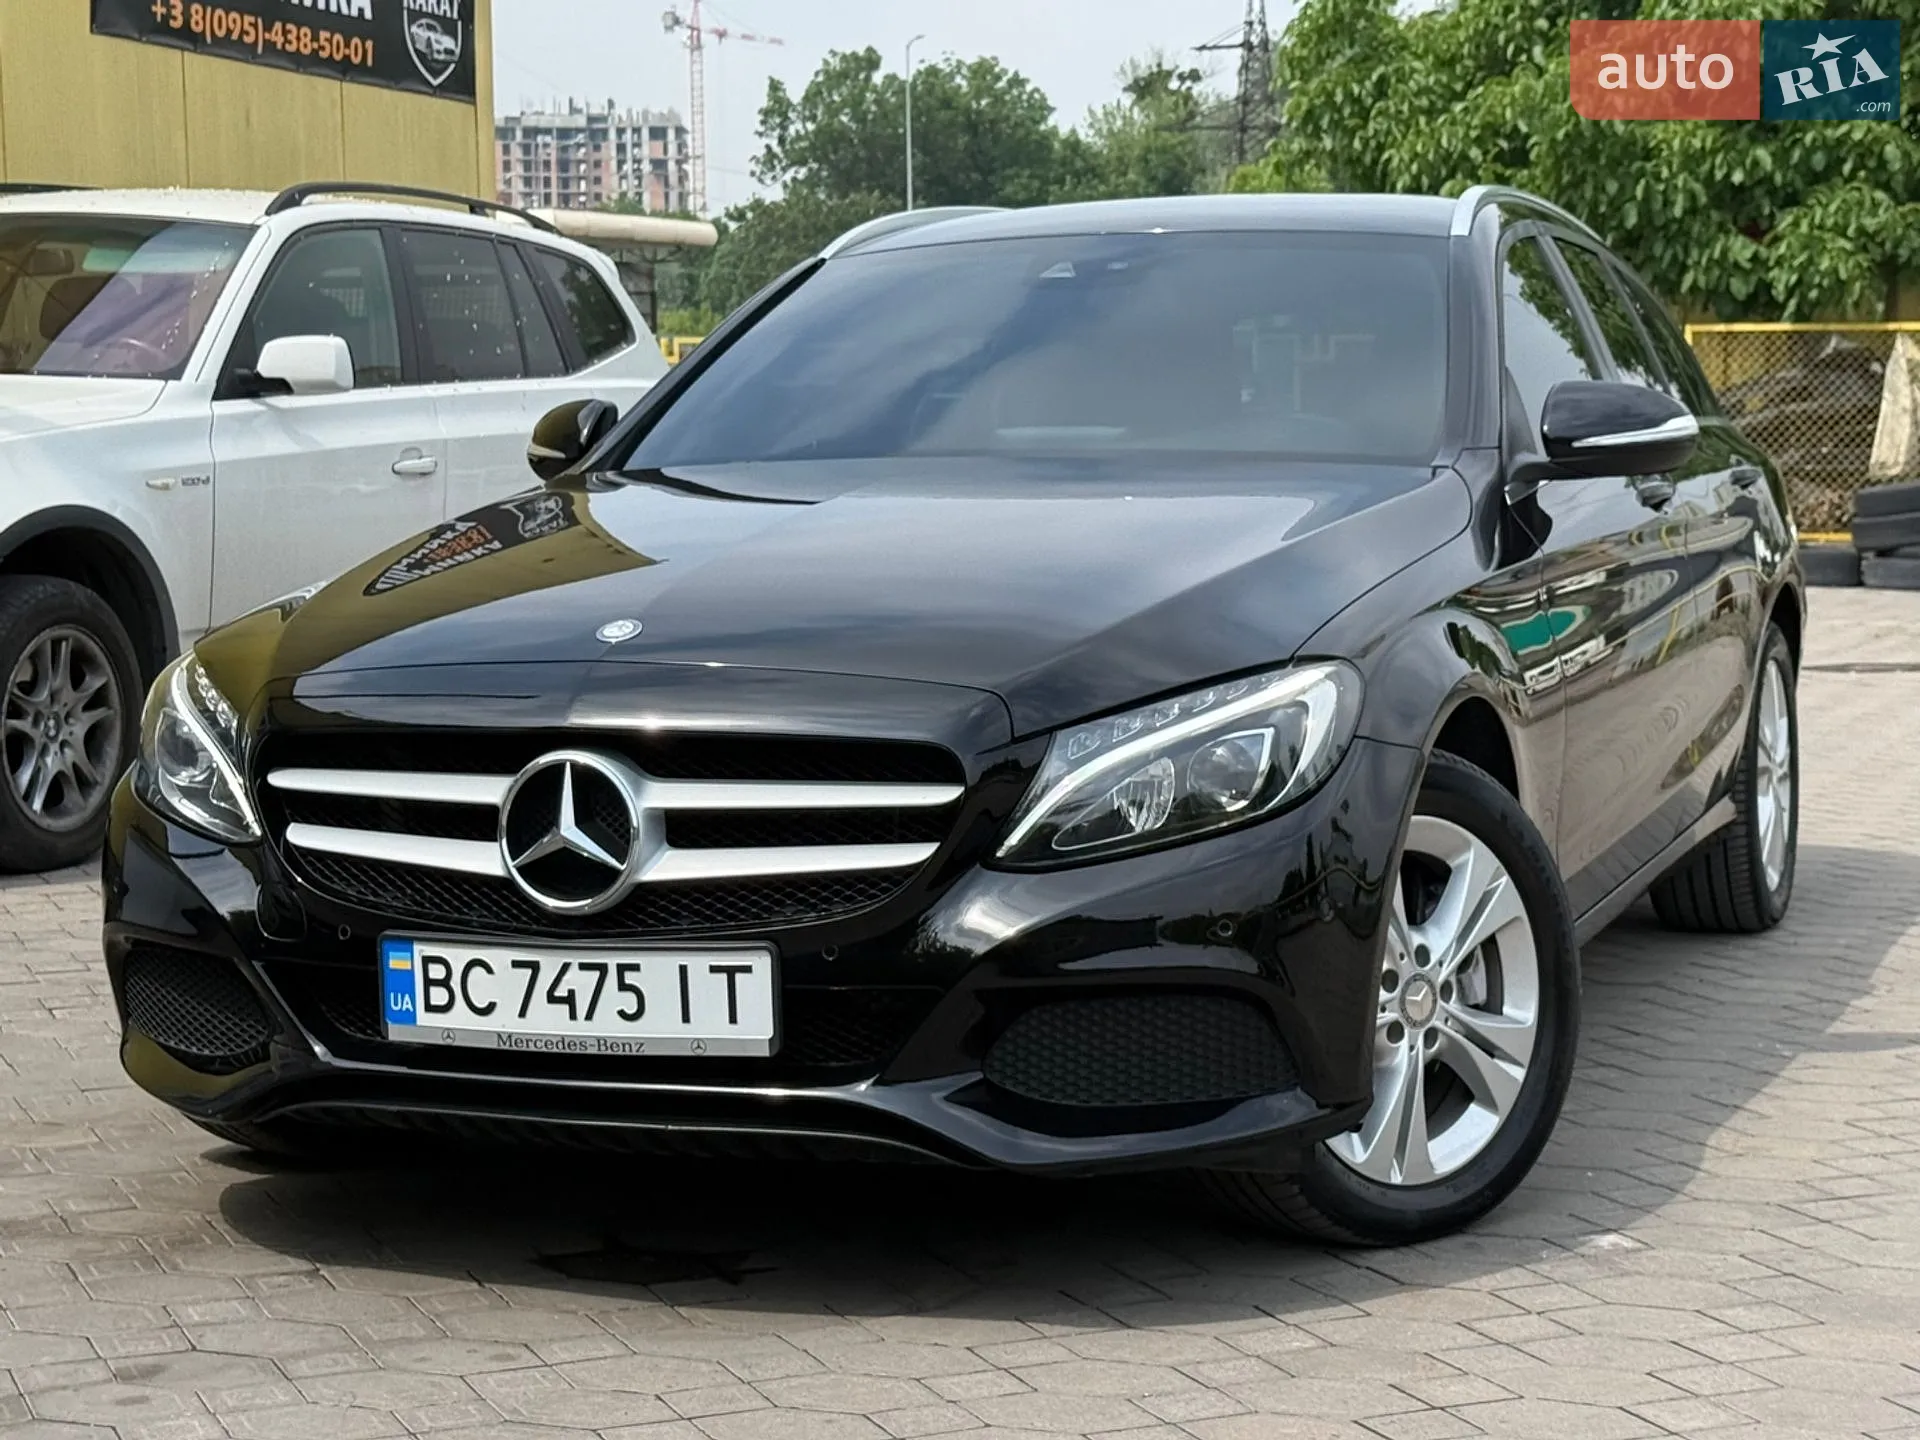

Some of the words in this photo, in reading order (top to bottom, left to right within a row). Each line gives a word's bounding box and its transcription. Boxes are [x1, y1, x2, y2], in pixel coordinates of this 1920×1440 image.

[421, 954, 498, 1016] BC
[511, 959, 646, 1023] 7475
[678, 963, 753, 1025] IT
[390, 991, 414, 1012] UA
[496, 1033, 646, 1054] Mercedes-Benz
